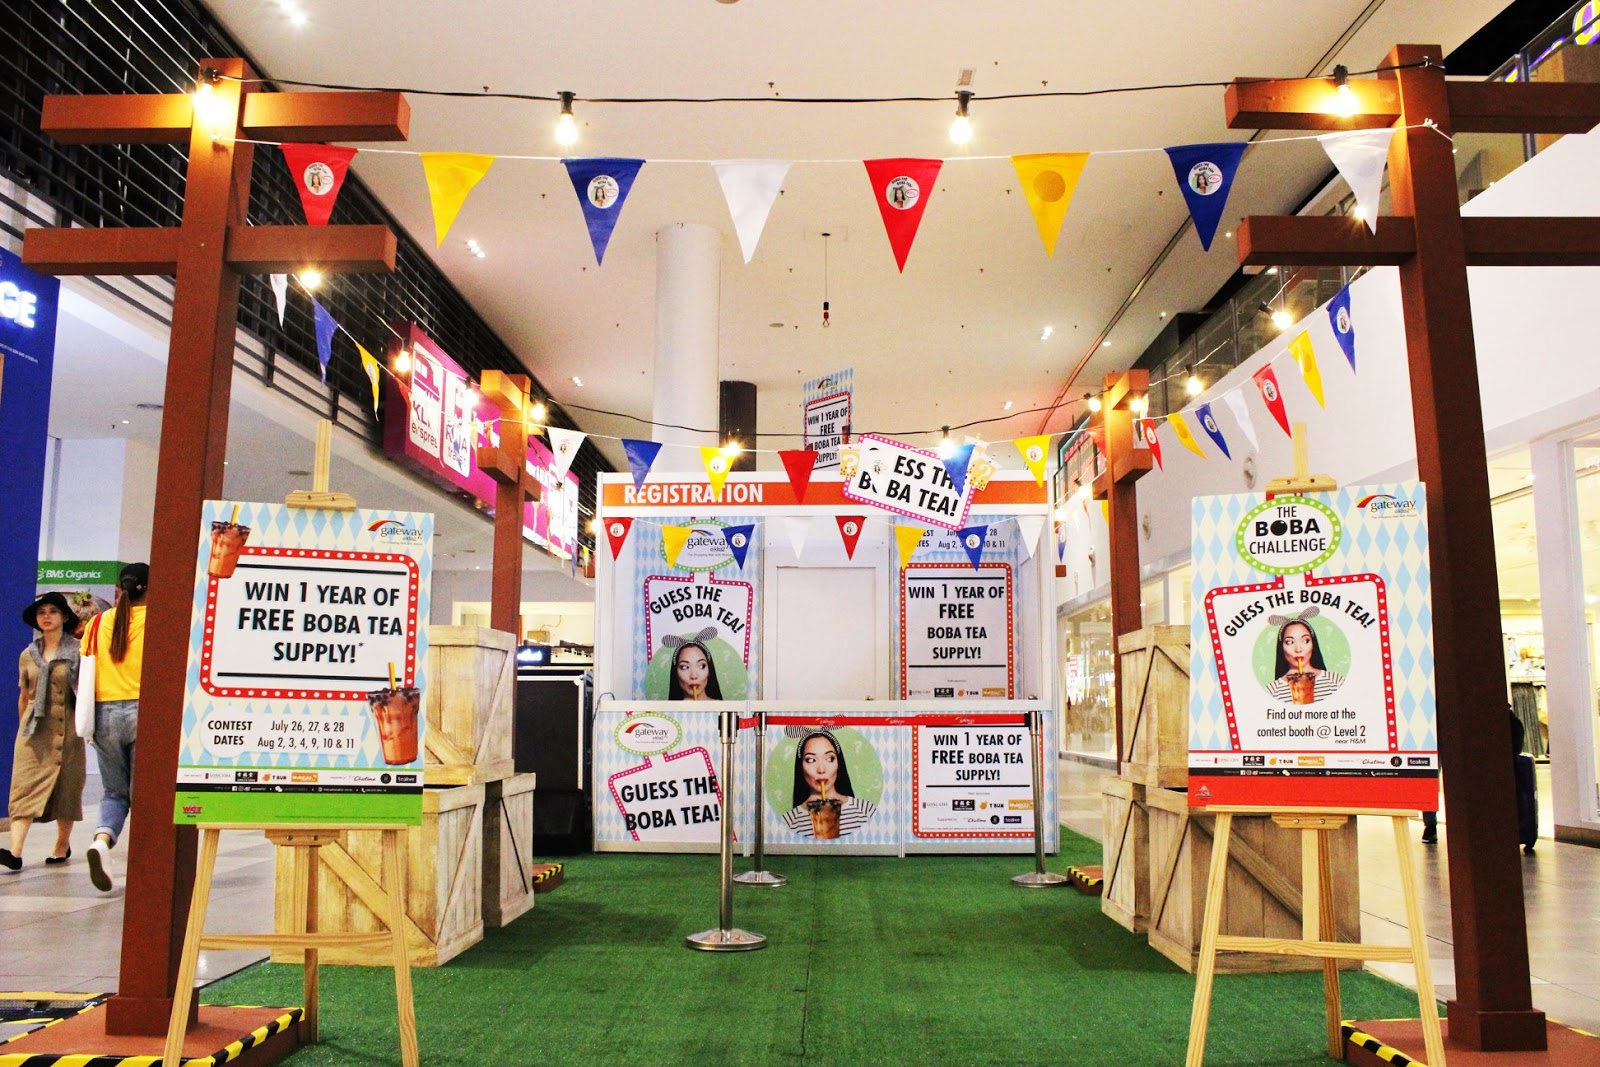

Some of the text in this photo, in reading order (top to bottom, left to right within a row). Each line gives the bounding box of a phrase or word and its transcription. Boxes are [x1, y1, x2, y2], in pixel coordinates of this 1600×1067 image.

[808, 407, 848, 426] WIN 1 YEAR OF
[820, 423, 835, 435] FREE
[814, 436, 840, 450] BOBA TEA
[624, 483, 763, 504] REGISTRATION
[858, 471, 958, 517] BBA TEA!
[1276, 506, 1297, 519] THE
[1370, 500, 1416, 513] gateway
[380, 526, 424, 537] gateway
[989, 528, 998, 536] 28
[938, 540, 950, 549] Aug
[1249, 538, 1326, 555] CHALLENGE
[245, 582, 400, 606] WIN 1 YEAR OF
[908, 584, 1005, 599] WIN 1 YEAR OF
[650, 586, 722, 614] GUESS THE
[939, 603, 975, 619] FREE
[1224, 589, 1376, 637] GUESS THE BOBA TEA!
[238, 608, 403, 636] FREE BOBA TEA
[673, 603, 745, 634] BOBA TEA!
[927, 627, 987, 639] BOBA TEA
[932, 647, 981, 659] SUPPLY!
[1266, 707, 1356, 720] Find out more at the
[207, 720, 345, 733] CONTEST July 26, 27, & 28
[635, 729, 668, 738] gateway
[1257, 725, 1366, 739] contest booth @ Level 2
[213, 735, 354, 749] DATES Aug 2, 3, 4, 9, 10 & 11
[934, 732, 1022, 746] WIN 1 YEAR OF
[932, 750, 1024, 764] FREE BOBA TEA
[955, 769, 1000, 781] SUPPLY!
[621, 776, 717, 803] GUESS THE
[626, 804, 719, 831] BOBA TEA!
